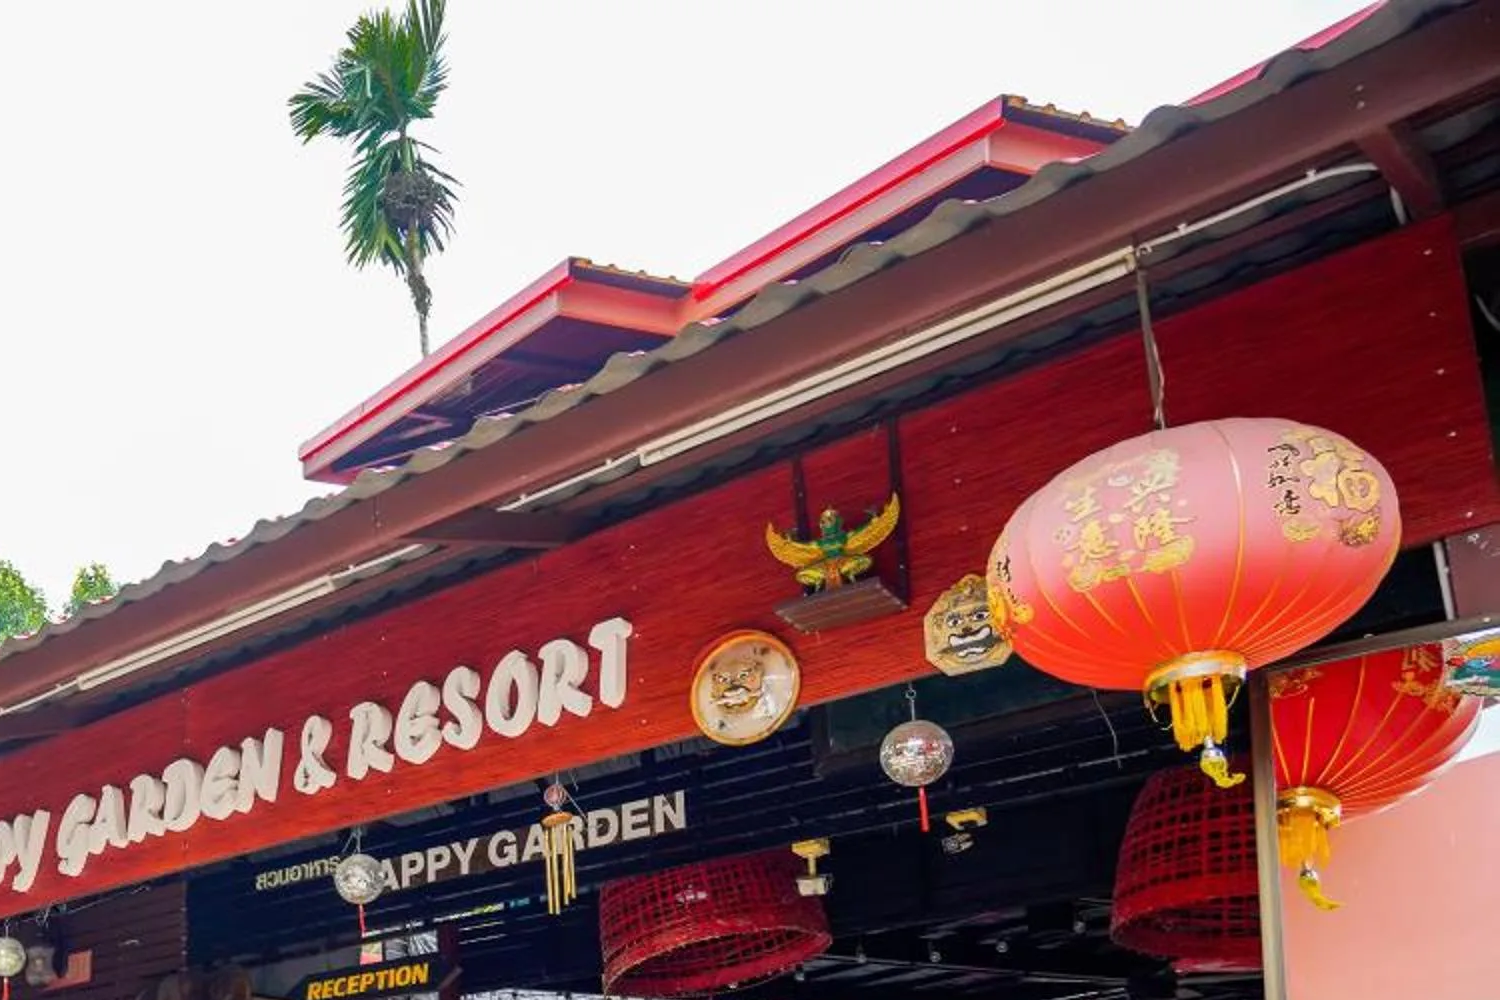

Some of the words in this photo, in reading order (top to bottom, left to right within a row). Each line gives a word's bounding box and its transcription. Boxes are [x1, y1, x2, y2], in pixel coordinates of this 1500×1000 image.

[56, 727, 284, 877] GARDEN
[293, 714, 337, 795] &
[346, 616, 633, 781] RESORT
[378, 837, 479, 892] APPY
